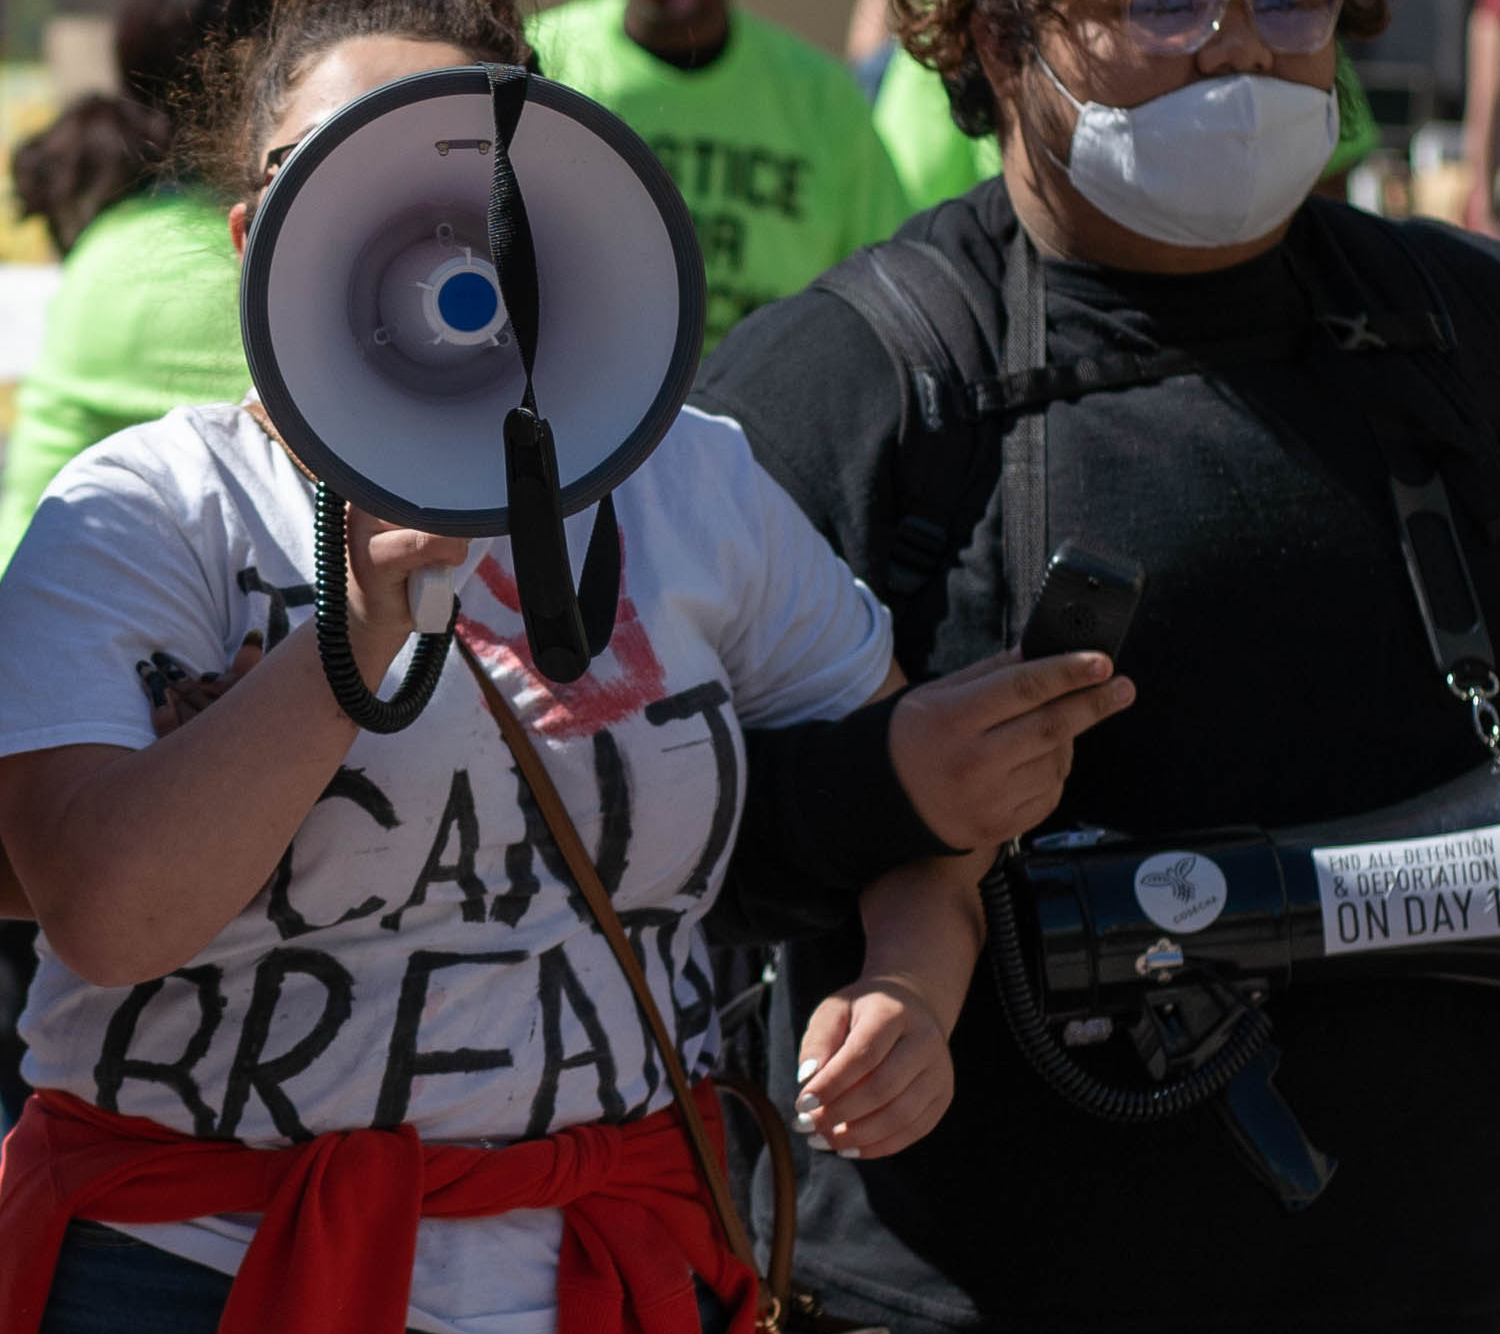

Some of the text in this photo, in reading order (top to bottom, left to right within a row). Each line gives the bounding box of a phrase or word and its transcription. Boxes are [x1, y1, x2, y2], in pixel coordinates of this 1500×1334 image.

[1329, 836, 1495, 872] END ALL DETENTION
[1333, 858, 1499, 899] & DEPORTATION
[1337, 898, 1390, 944] ON
[1403, 888, 1473, 937] DAY
